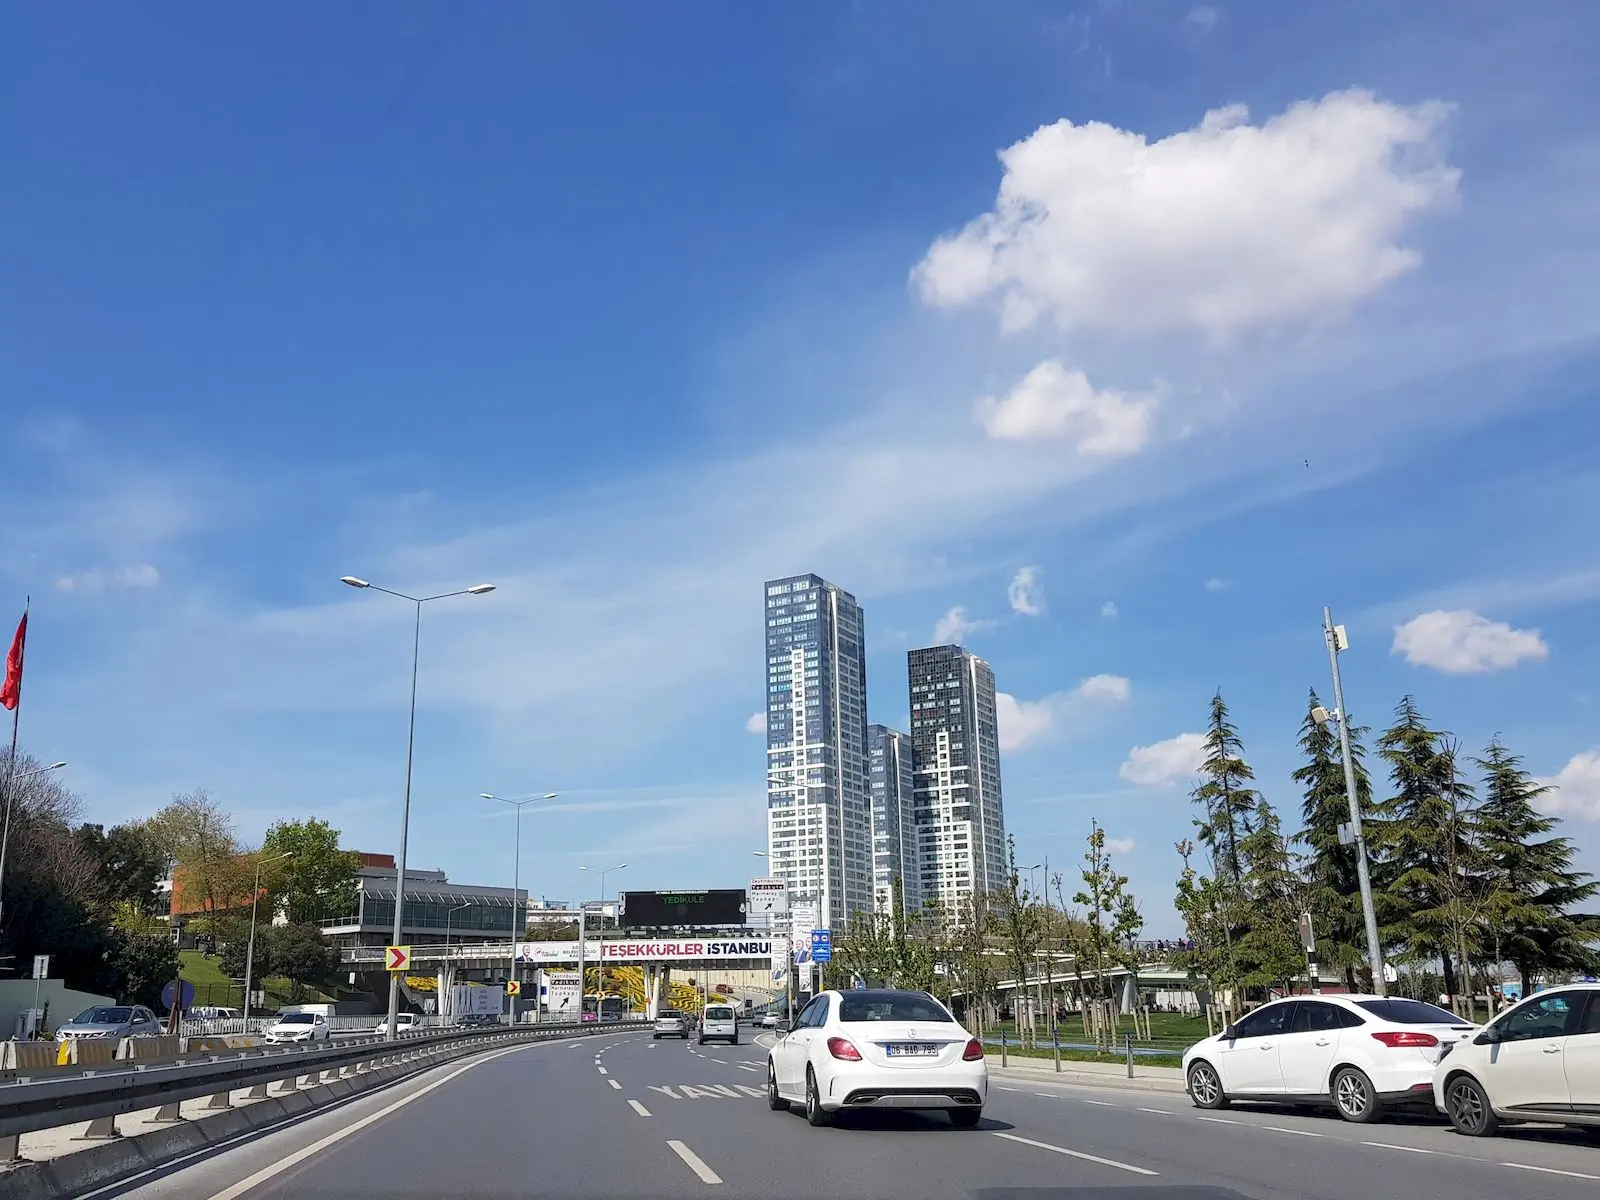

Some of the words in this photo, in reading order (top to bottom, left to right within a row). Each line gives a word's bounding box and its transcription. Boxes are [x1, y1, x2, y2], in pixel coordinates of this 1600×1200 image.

[662, 895, 705, 904] YEDİKULE
[600, 943, 703, 957] TEŞEKKÜRLER
[922, 1045, 937, 1054] 795
[647, 1083, 769, 1099] YAVA
